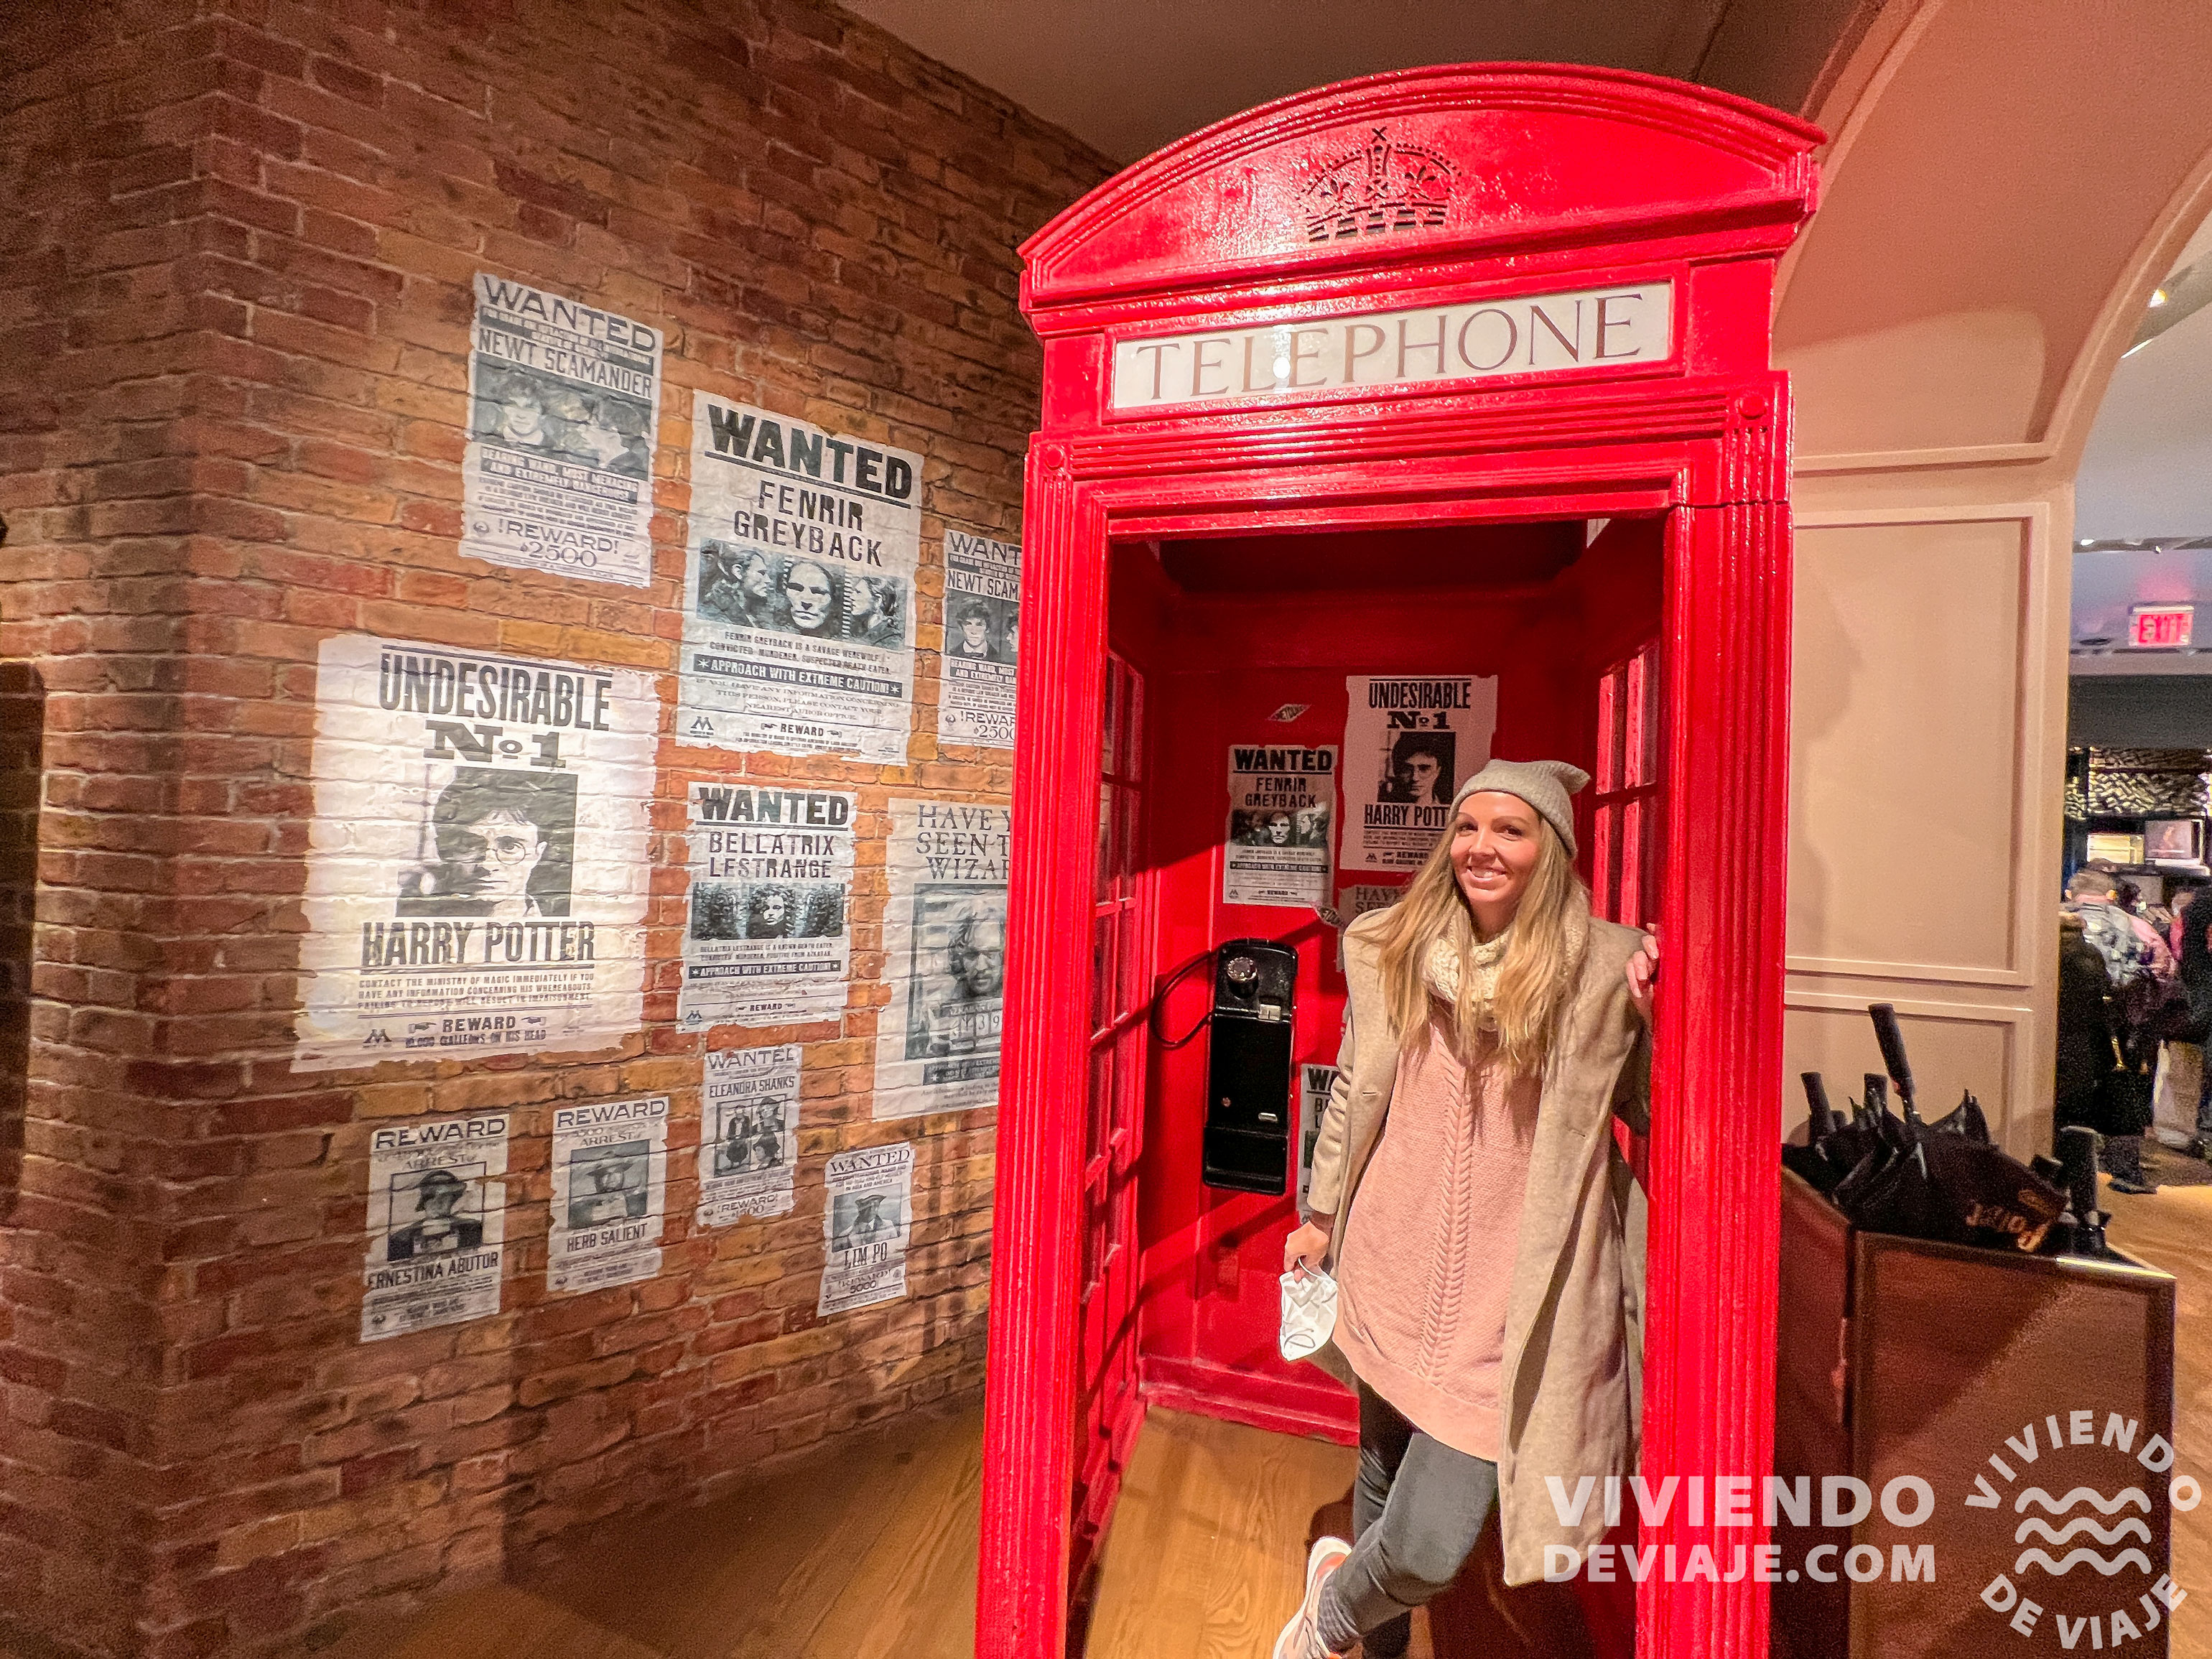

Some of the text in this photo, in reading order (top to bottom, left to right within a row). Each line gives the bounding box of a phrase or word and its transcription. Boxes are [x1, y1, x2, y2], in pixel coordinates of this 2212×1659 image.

[483, 276, 656, 353] WANTED
[1136, 294, 1643, 401] TELEPHONE
[479, 327, 537, 365] NEWT
[545, 348, 652, 399] SCAMANDER
[707, 404, 912, 499] WANTED
[758, 480, 863, 531] FENRIR
[734, 510, 883, 567] GREYBACK
[948, 570, 983, 592] NEWT
[710, 641, 754, 655] CONVICTED
[754, 636, 793, 649] GREYBACK
[795, 642, 802, 651] IS
[812, 644, 840, 656] SAVAGE
[710, 658, 767, 678] APPROACH
[769, 667, 796, 682] WITH
[798, 671, 845, 688] EXTREME
[378, 651, 613, 732] UNDESIRABLE
[761, 685, 781, 694] ANY
[1369, 682, 1472, 710] UNDESIRABLE
[783, 697, 819, 707] PLEASE
[820, 702, 858, 712] CONTACT
[780, 723, 824, 737] REWARD
[1235, 748, 1332, 771] WANTED
[1255, 776, 1307, 792] FENRIR
[699, 787, 850, 825] WANTED
[1245, 793, 1317, 809] GREYBACK
[918, 804, 993, 831] HAVE
[1365, 804, 1409, 825] HARRY
[709, 832, 835, 855] BELLATRIX
[916, 832, 988, 857] SEEN
[710, 857, 832, 879] LESTRANGE
[361, 920, 595, 966] HARRY POTTER
[359, 979, 402, 988] CONTACT
[484, 975, 510, 984] MAGIC
[514, 974, 567, 983] IMMEDIATELY
[700, 966, 740, 977] APPROACH
[763, 962, 797, 973] EXTREME
[406, 988, 465, 998] INFORMATION
[467, 985, 517, 995] CONCERNING
[520, 985, 533, 993] HIS
[750, 1003, 783, 1012] REWARD
[442, 1016, 516, 1033] REWARD
[709, 1076, 795, 1098] ELEANDRA SHANKS
[557, 1100, 665, 1128] REWARD
[376, 1118, 506, 1149] REWARD
[830, 1149, 910, 1174] WANTED
[567, 1223, 648, 1253] HERB SALIENT
[844, 1246, 868, 1270] LIM
[873, 1242, 888, 1263] PO
[850, 1280, 877, 1294] 5000
